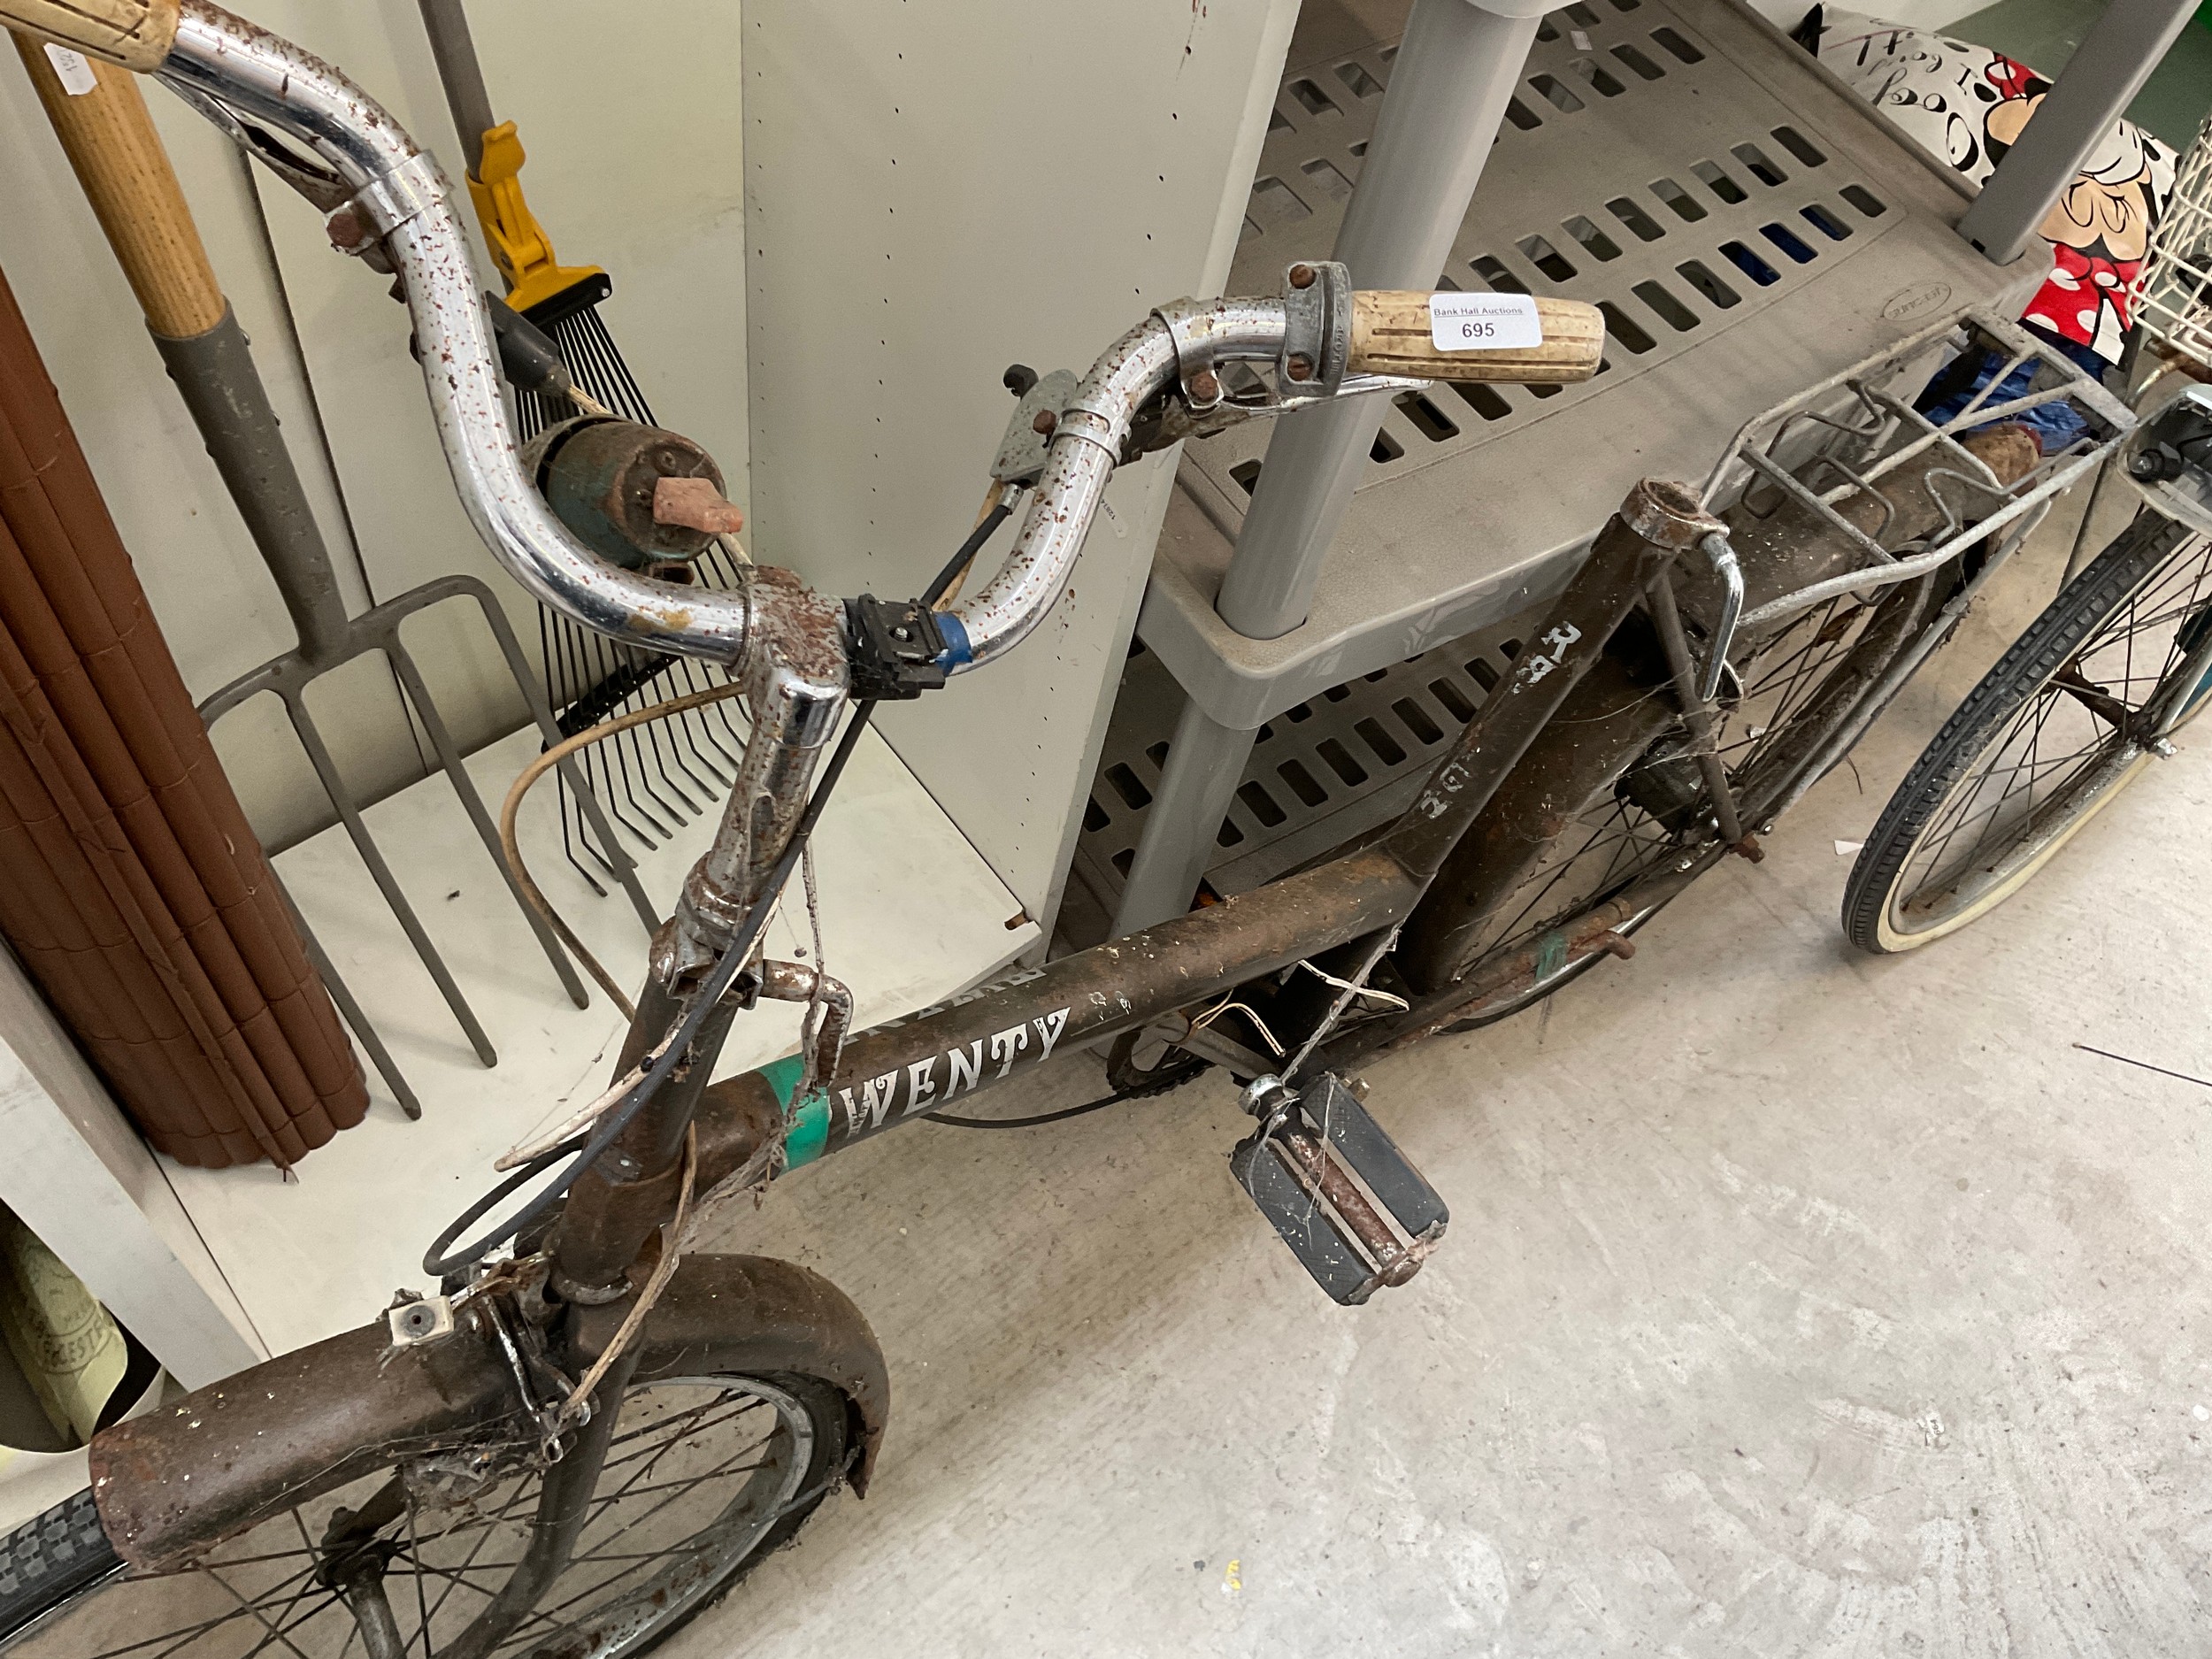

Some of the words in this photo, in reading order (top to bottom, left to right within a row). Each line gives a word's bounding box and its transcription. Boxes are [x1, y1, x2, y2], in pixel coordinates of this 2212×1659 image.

[1481, 306, 1524, 315] Auctions
[1462, 322, 1495, 338] 695
[828, 1006, 1071, 1139] WENTY
